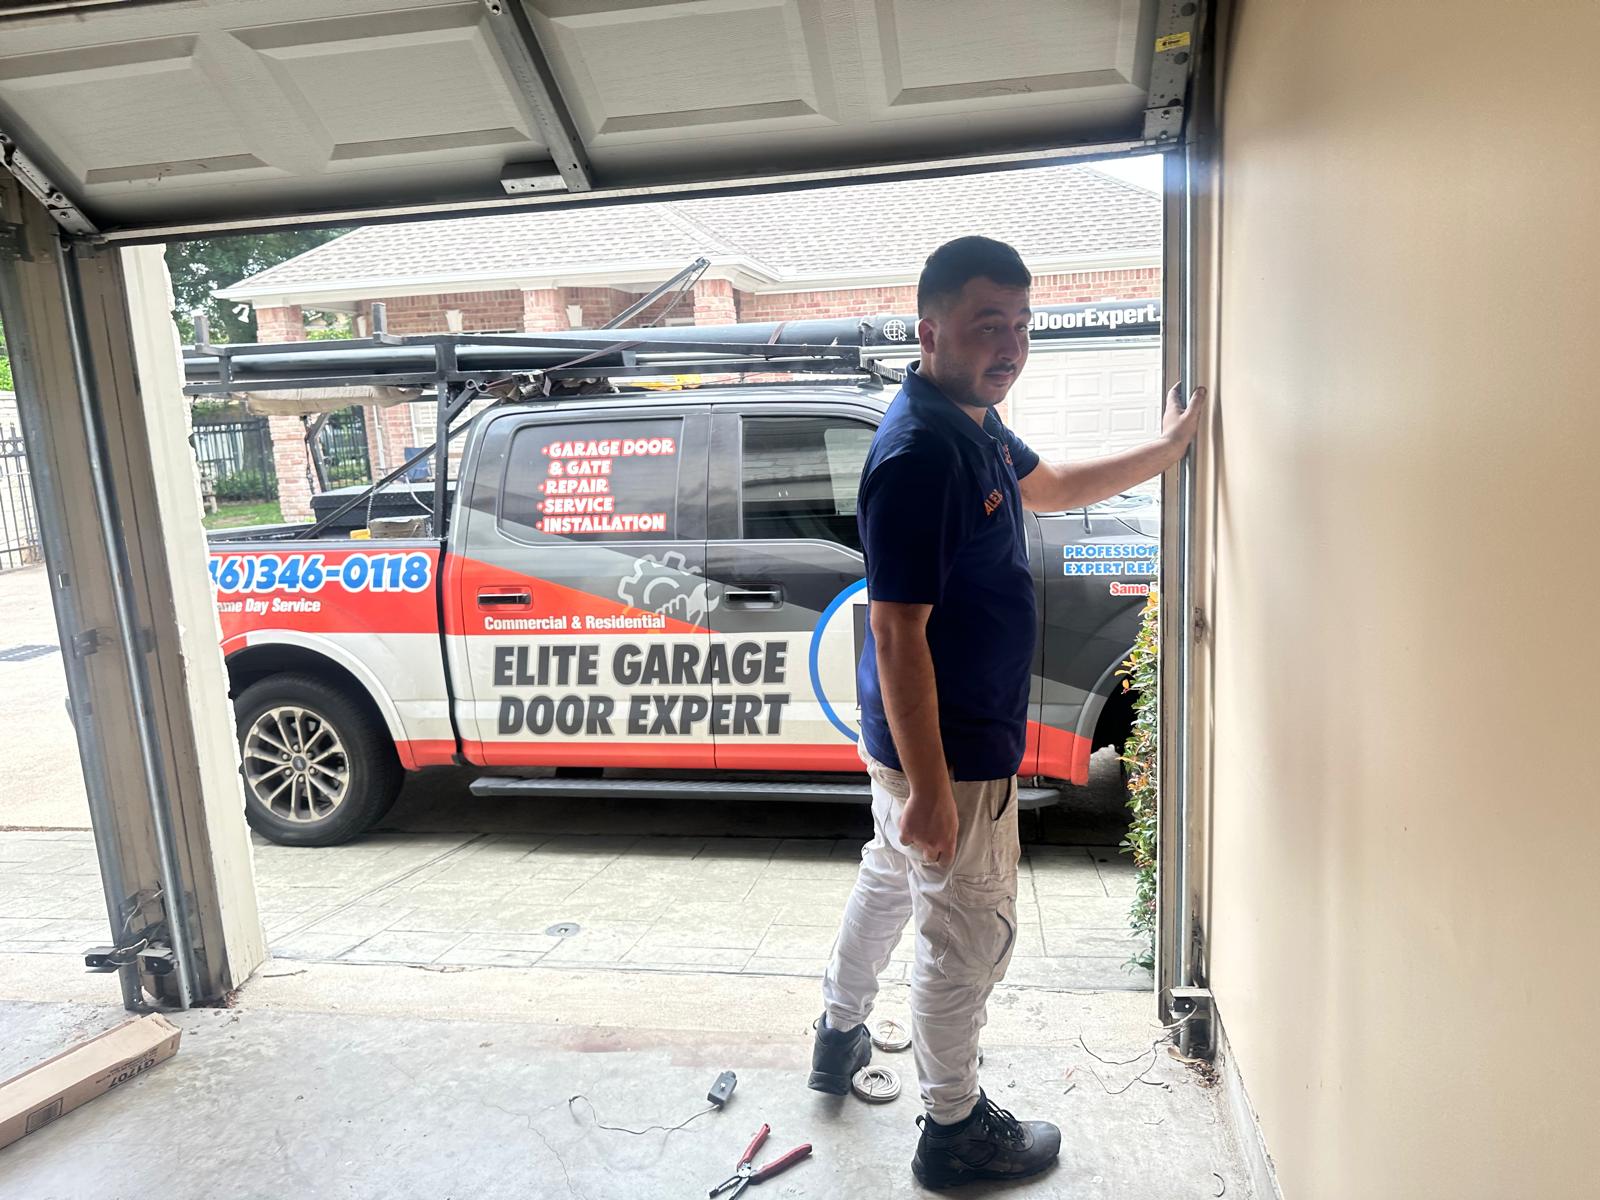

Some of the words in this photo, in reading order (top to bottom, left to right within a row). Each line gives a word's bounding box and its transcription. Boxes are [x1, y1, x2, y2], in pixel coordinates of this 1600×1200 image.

[549, 440, 620, 458] GARAGE
[621, 439, 674, 455] DOOR
[550, 460, 562, 475] &
[566, 460, 612, 475] GATE
[545, 478, 609, 495] REPAIR
[544, 497, 613, 514] SERVICE
[543, 514, 666, 533] INSTALLATION
[1064, 562, 1123, 575] EXPERT
[1110, 583, 1148, 595] Same
[245, 598, 268, 615] Day
[271, 598, 321, 613] Service
[484, 615, 567, 630] Commercial
[571, 616, 582, 629] &
[585, 615, 666, 629] Residential
[493, 644, 600, 687] ELITE
[611, 641, 789, 686] GARAGE
[498, 694, 615, 736] DOOR
[626, 692, 792, 736] EXPERT
